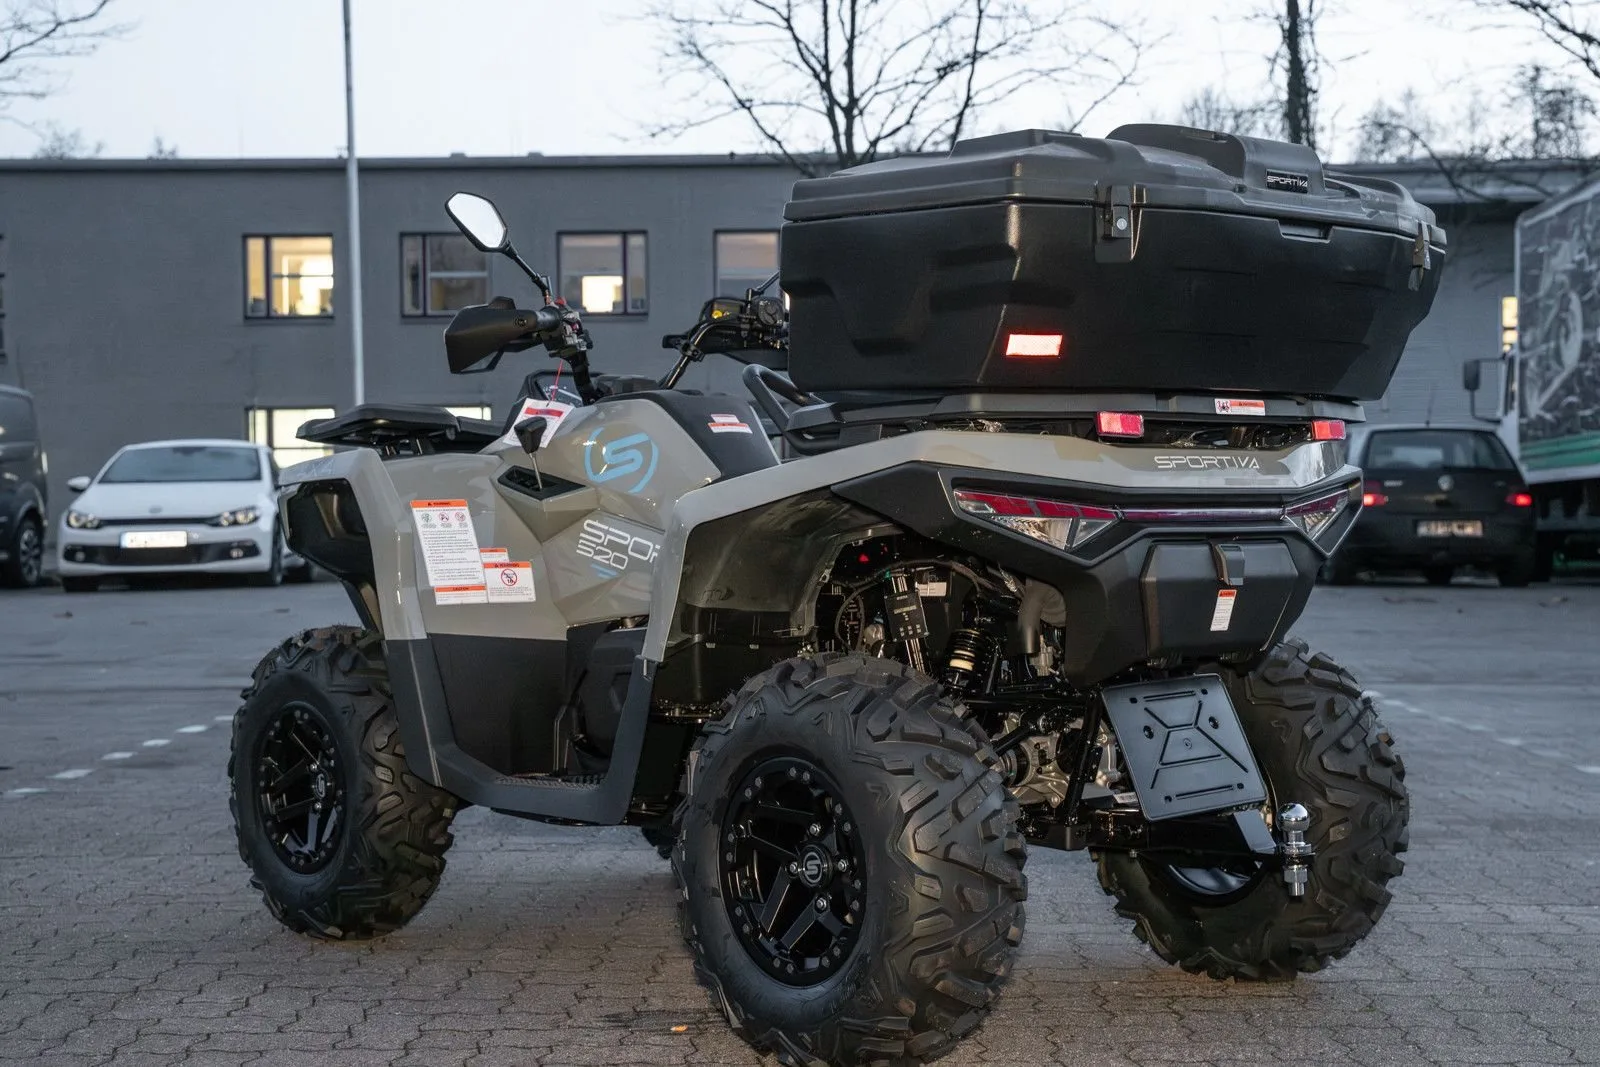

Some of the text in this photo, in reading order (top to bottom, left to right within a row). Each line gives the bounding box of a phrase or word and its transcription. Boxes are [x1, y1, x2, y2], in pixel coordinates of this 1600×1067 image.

[1266, 175, 1308, 188] SPORTIVA
[1154, 455, 1260, 469] SPORTIVA
[576, 539, 628, 570] 520
